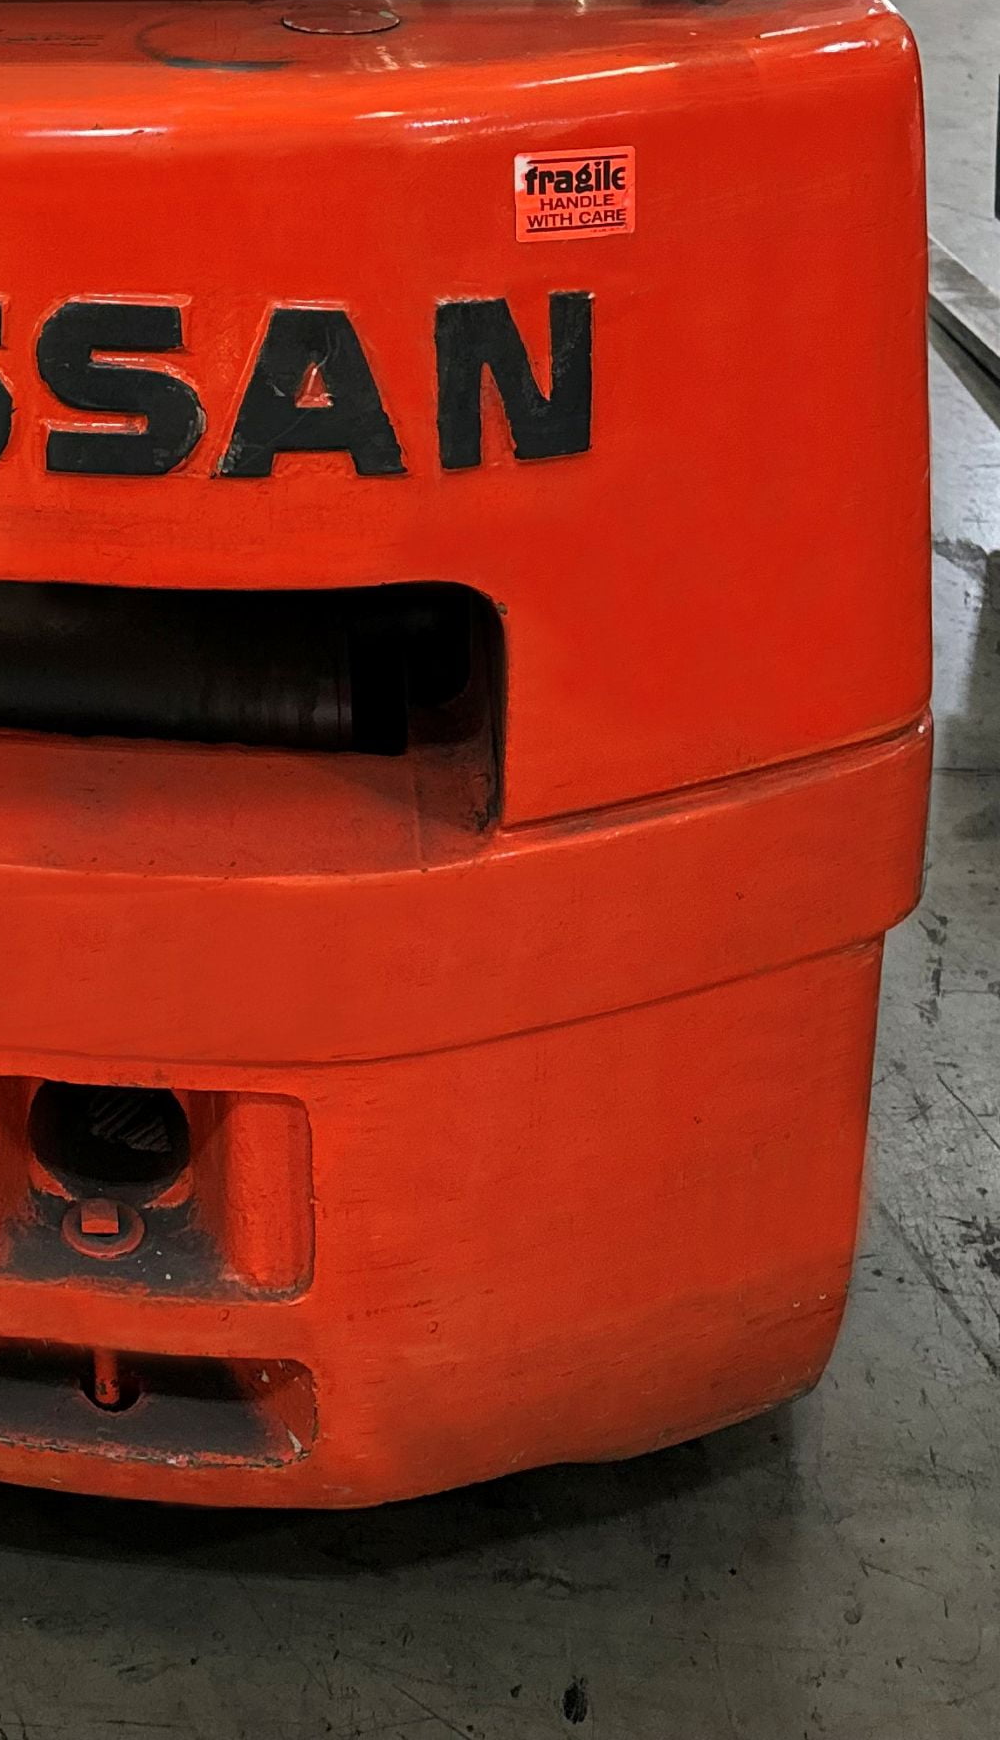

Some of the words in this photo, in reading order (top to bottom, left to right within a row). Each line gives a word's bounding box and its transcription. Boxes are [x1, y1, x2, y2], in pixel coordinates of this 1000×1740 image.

[525, 160, 626, 196] fragile
[540, 193, 615, 211] HANDLE
[527, 211, 573, 228] WITH
[578, 208, 627, 225] CARE
